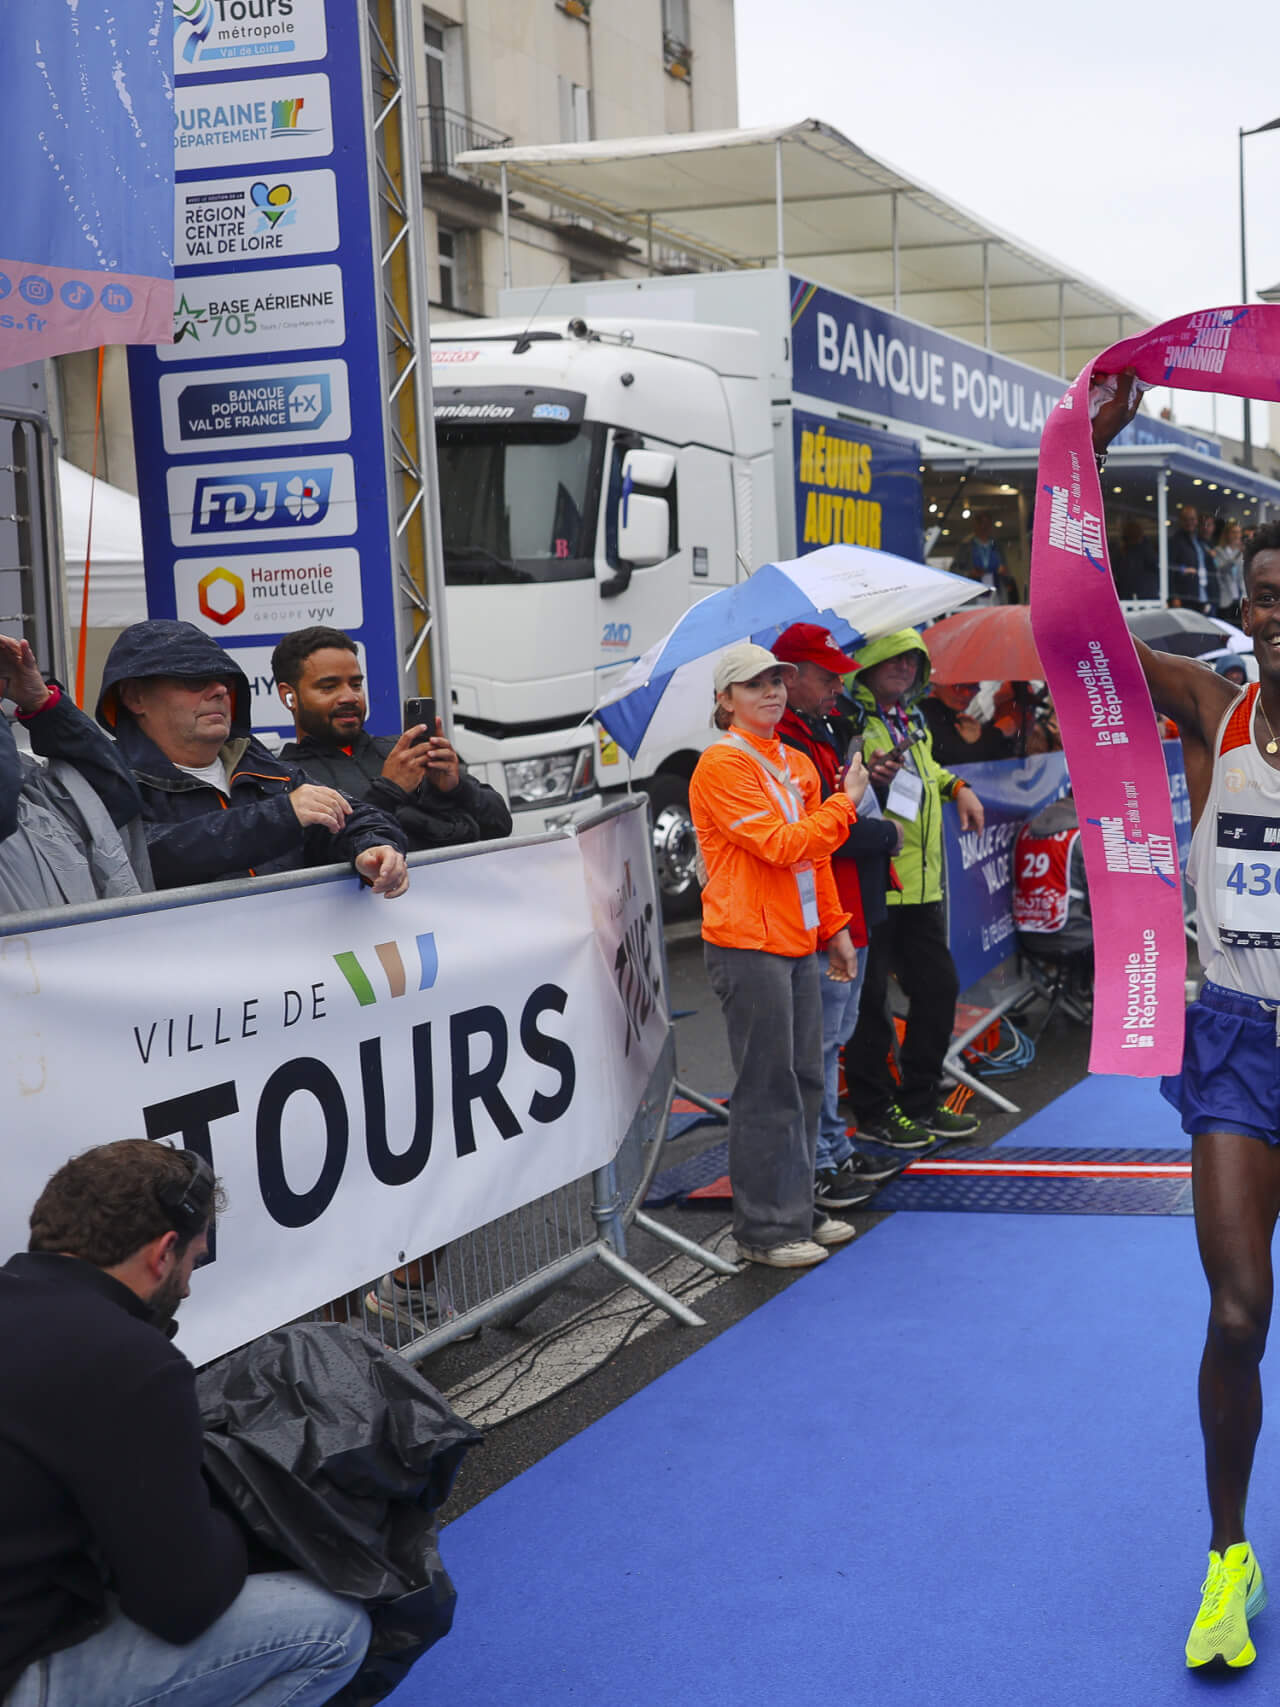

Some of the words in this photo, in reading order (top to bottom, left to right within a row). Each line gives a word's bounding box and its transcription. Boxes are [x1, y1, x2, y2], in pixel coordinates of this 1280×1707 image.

[214, 0, 293, 22] Tours
[218, 22, 295, 40] métropole
[220, 47, 237, 57] Val
[174, 102, 267, 130] URAINE
[185, 205, 246, 224] RÉGION
[185, 222, 245, 240] CENTRE
[186, 242, 213, 256] VAL
[218, 239, 236, 253] DE
[241, 234, 284, 251] LOIRE
[209, 299, 249, 315] BASE
[254, 291, 334, 312] AÉRIENNE
[210, 313, 257, 337] 705
[1193, 327, 1231, 349] LOIRE
[1164, 346, 1226, 374] RUNNING
[817, 312, 946, 406] BANQUE
[953, 362, 1058, 433] POPULAI
[229, 386, 285, 402] BANQUE
[211, 398, 285, 416] POPULAIRE
[433, 403, 514, 418] anisation
[189, 419, 213, 432] VAL
[215, 416, 232, 430] DE
[235, 412, 287, 427] FRANCE
[800, 425, 872, 494] RÉUNIS
[200, 482, 278, 525] FDJ
[803, 491, 882, 550] AUTOUR
[1048, 486, 1069, 549] RUNNING
[1064, 518, 1083, 556] LOIRE
[251, 563, 333, 583] Harmonie
[252, 580, 334, 598] mutuelle
[308, 607, 335, 622] vyv
[1076, 660, 1107, 728] Nouvelle
[1088, 641, 1125, 726] République
[1095, 731, 1112, 746] la
[1100, 816, 1130, 872] RUNNING
[1022, 852, 1050, 878] 29
[1126, 841, 1153, 874] LOIRE
[1138, 929, 1160, 1028] République
[1122, 953, 1141, 1029] Nouvelle
[134, 999, 258, 1063] VILLE
[283, 983, 326, 1027] DE
[1121, 1033, 1139, 1049] la
[142, 984, 576, 1265] TOURS
